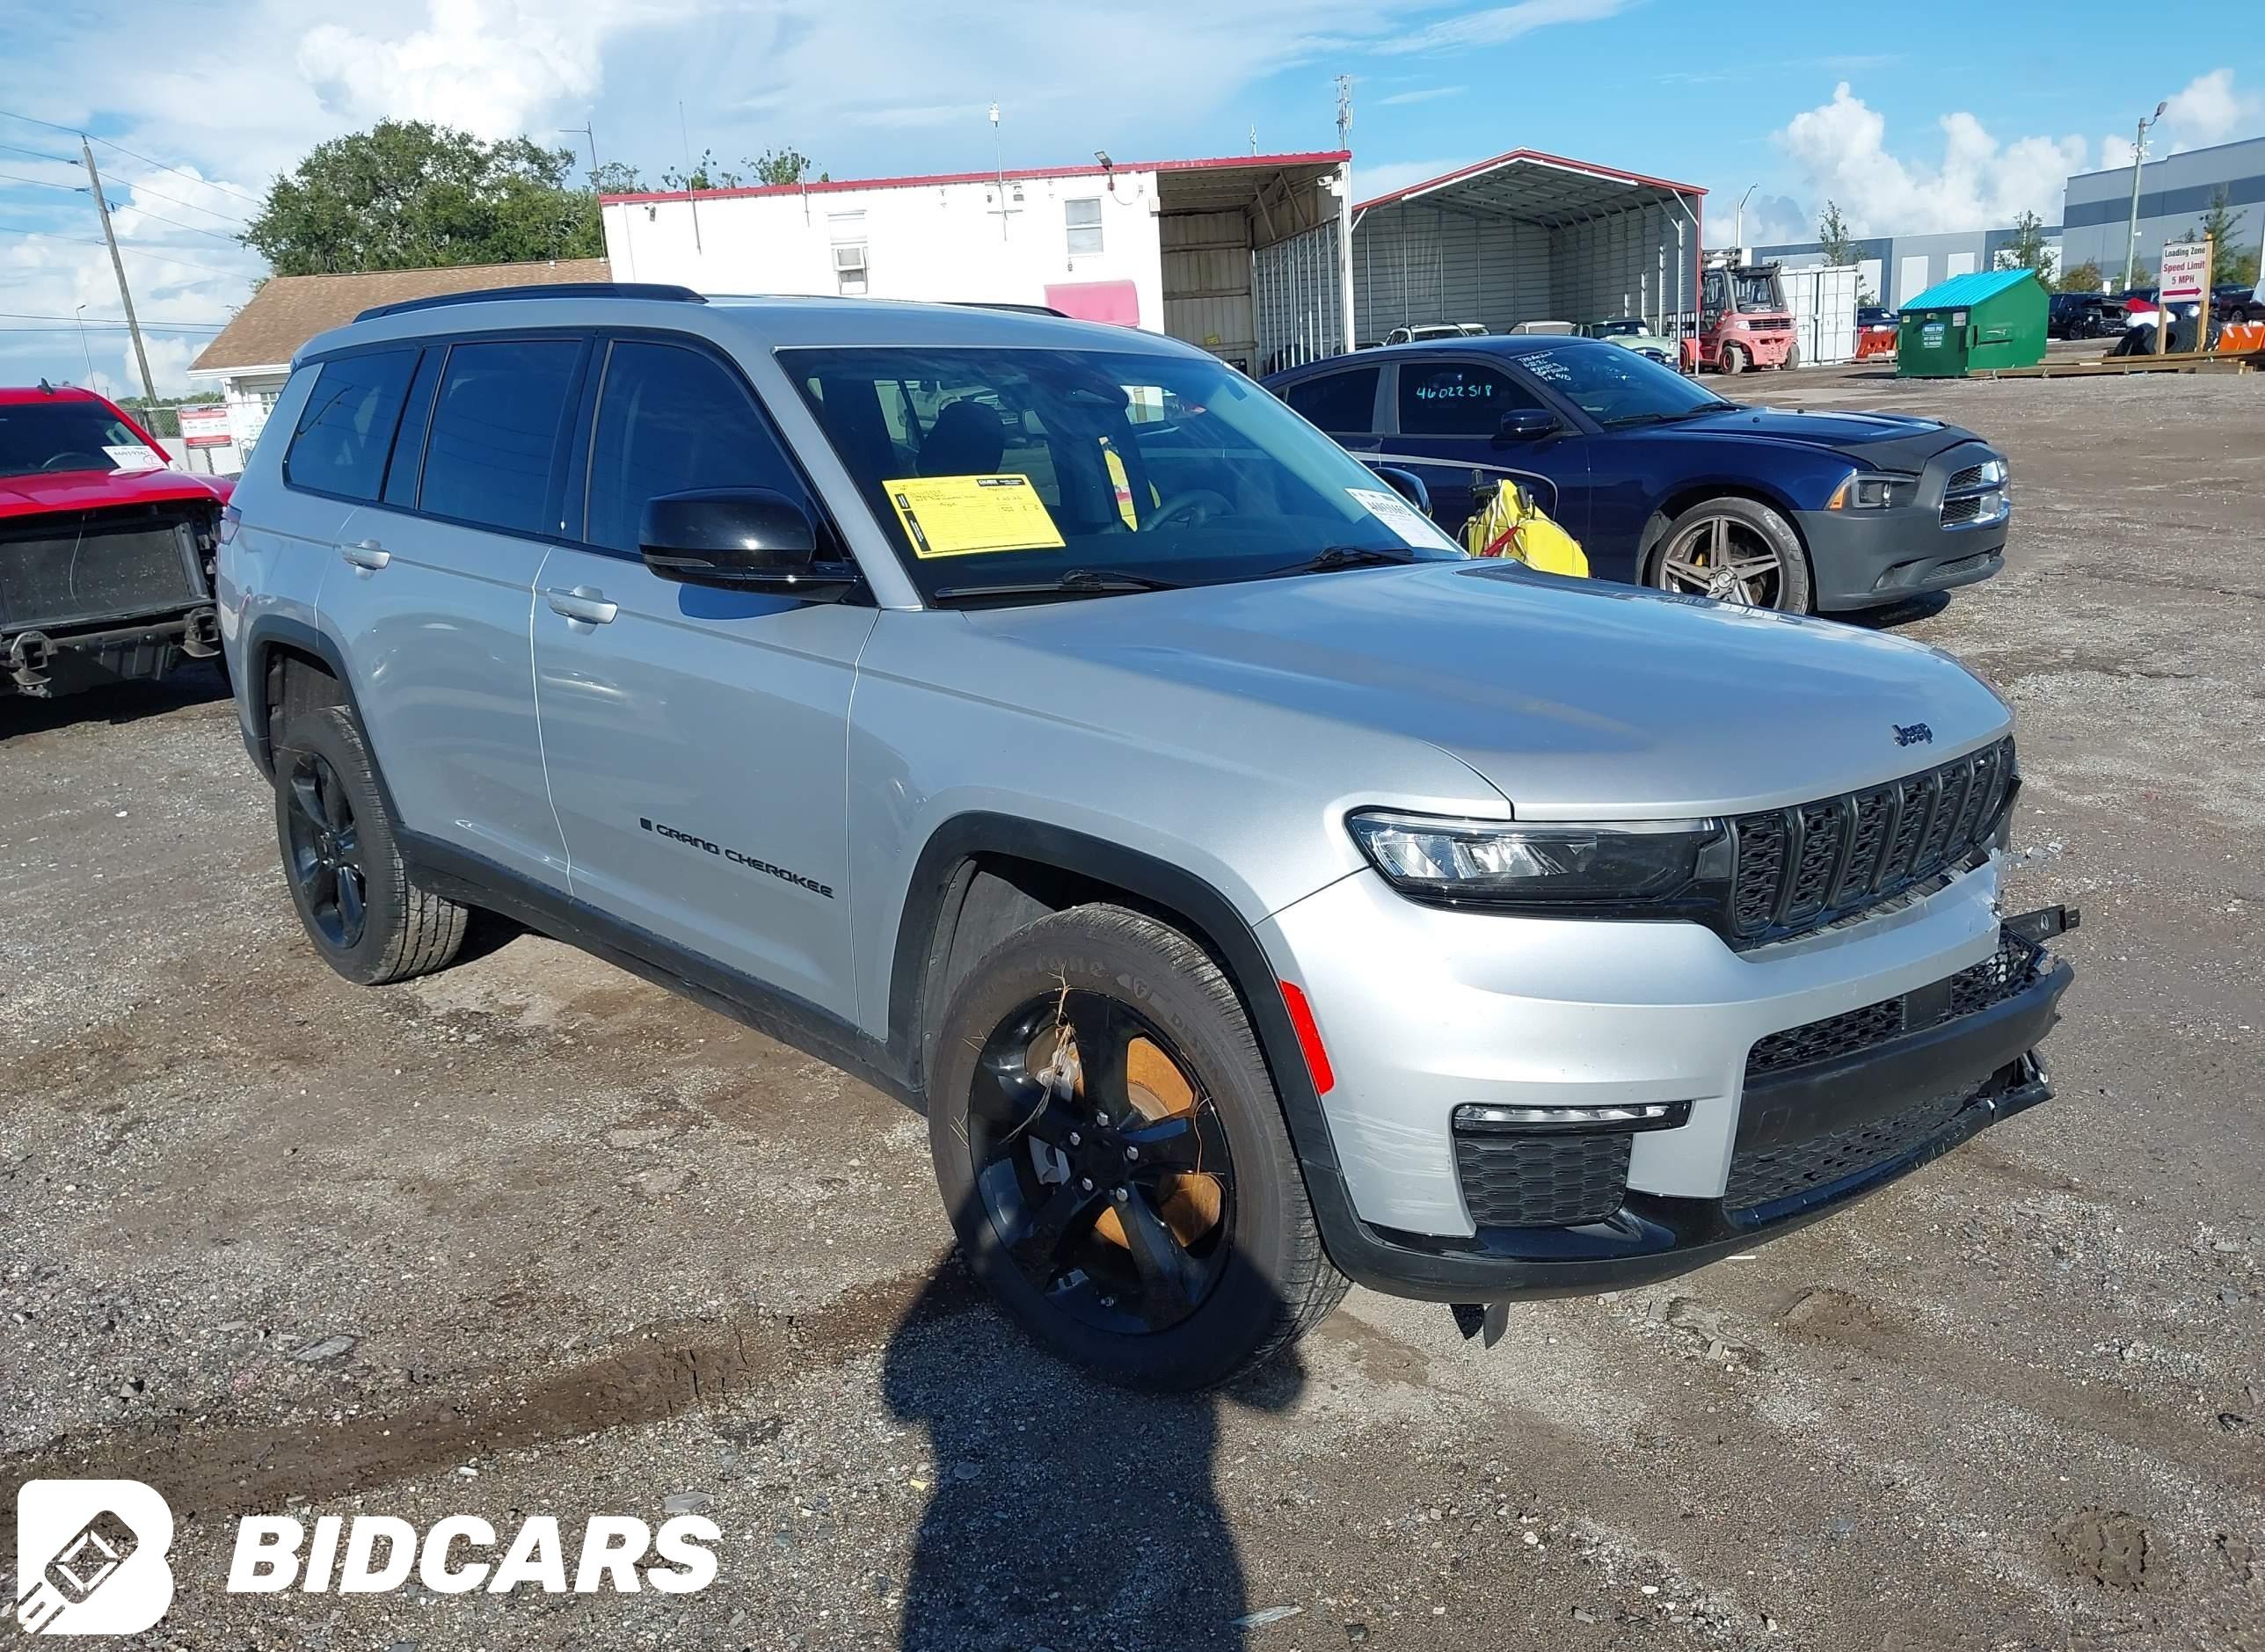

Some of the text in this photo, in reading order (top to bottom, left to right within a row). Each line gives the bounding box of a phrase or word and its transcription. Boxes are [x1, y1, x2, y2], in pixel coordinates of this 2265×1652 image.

[2165, 248, 2189, 258] Loading
[2163, 260, 2205, 273] Speed Limit
[2171, 274, 2195, 285] 5 MPH
[1891, 723, 1934, 747] Jeep
[656, 823, 834, 899] GRAND CHEROKEE
